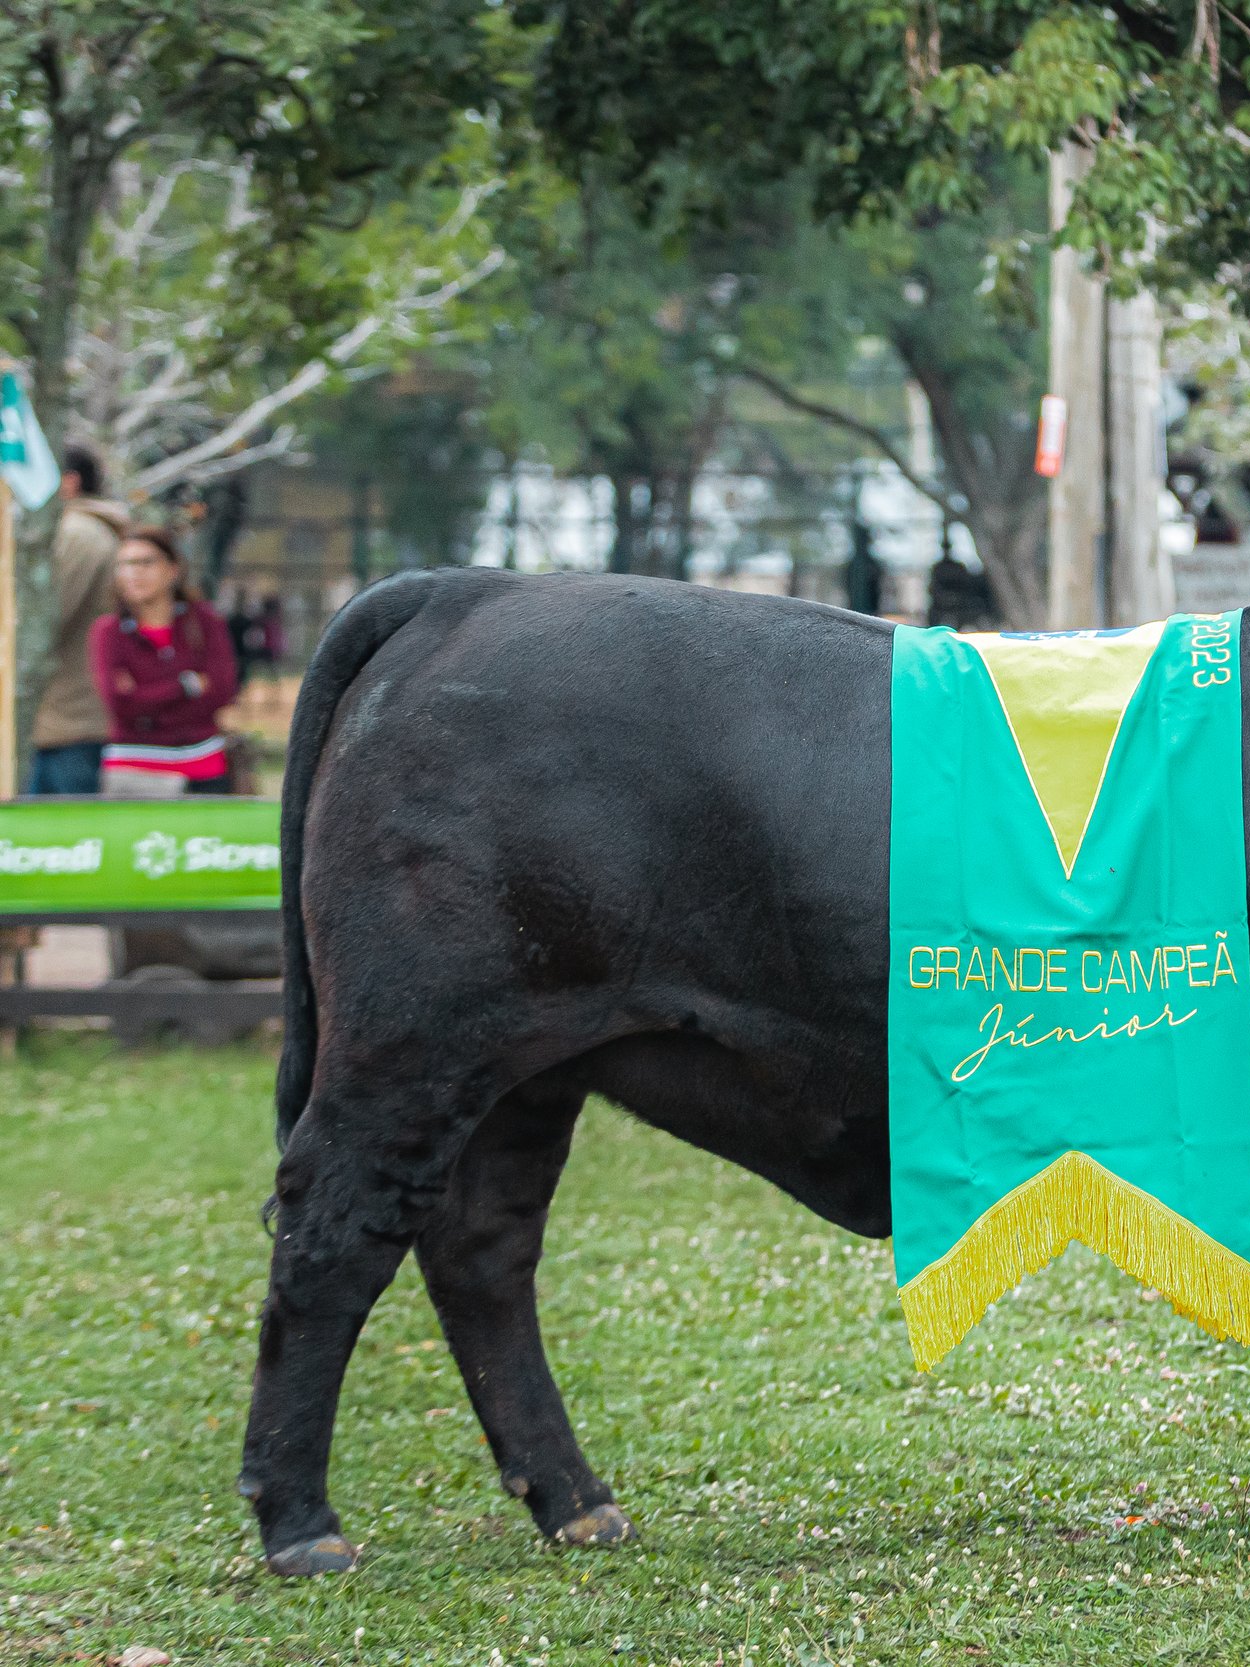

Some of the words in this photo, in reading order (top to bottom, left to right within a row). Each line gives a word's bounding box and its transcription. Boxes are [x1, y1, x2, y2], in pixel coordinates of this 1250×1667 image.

[1191, 621, 1230, 687] 2023
[185, 837, 279, 871] Sicre
[909, 945, 1068, 993] GRANDE
[1081, 930, 1238, 994] CAMPEÃ
[951, 1002, 1198, 1083] Júnior
